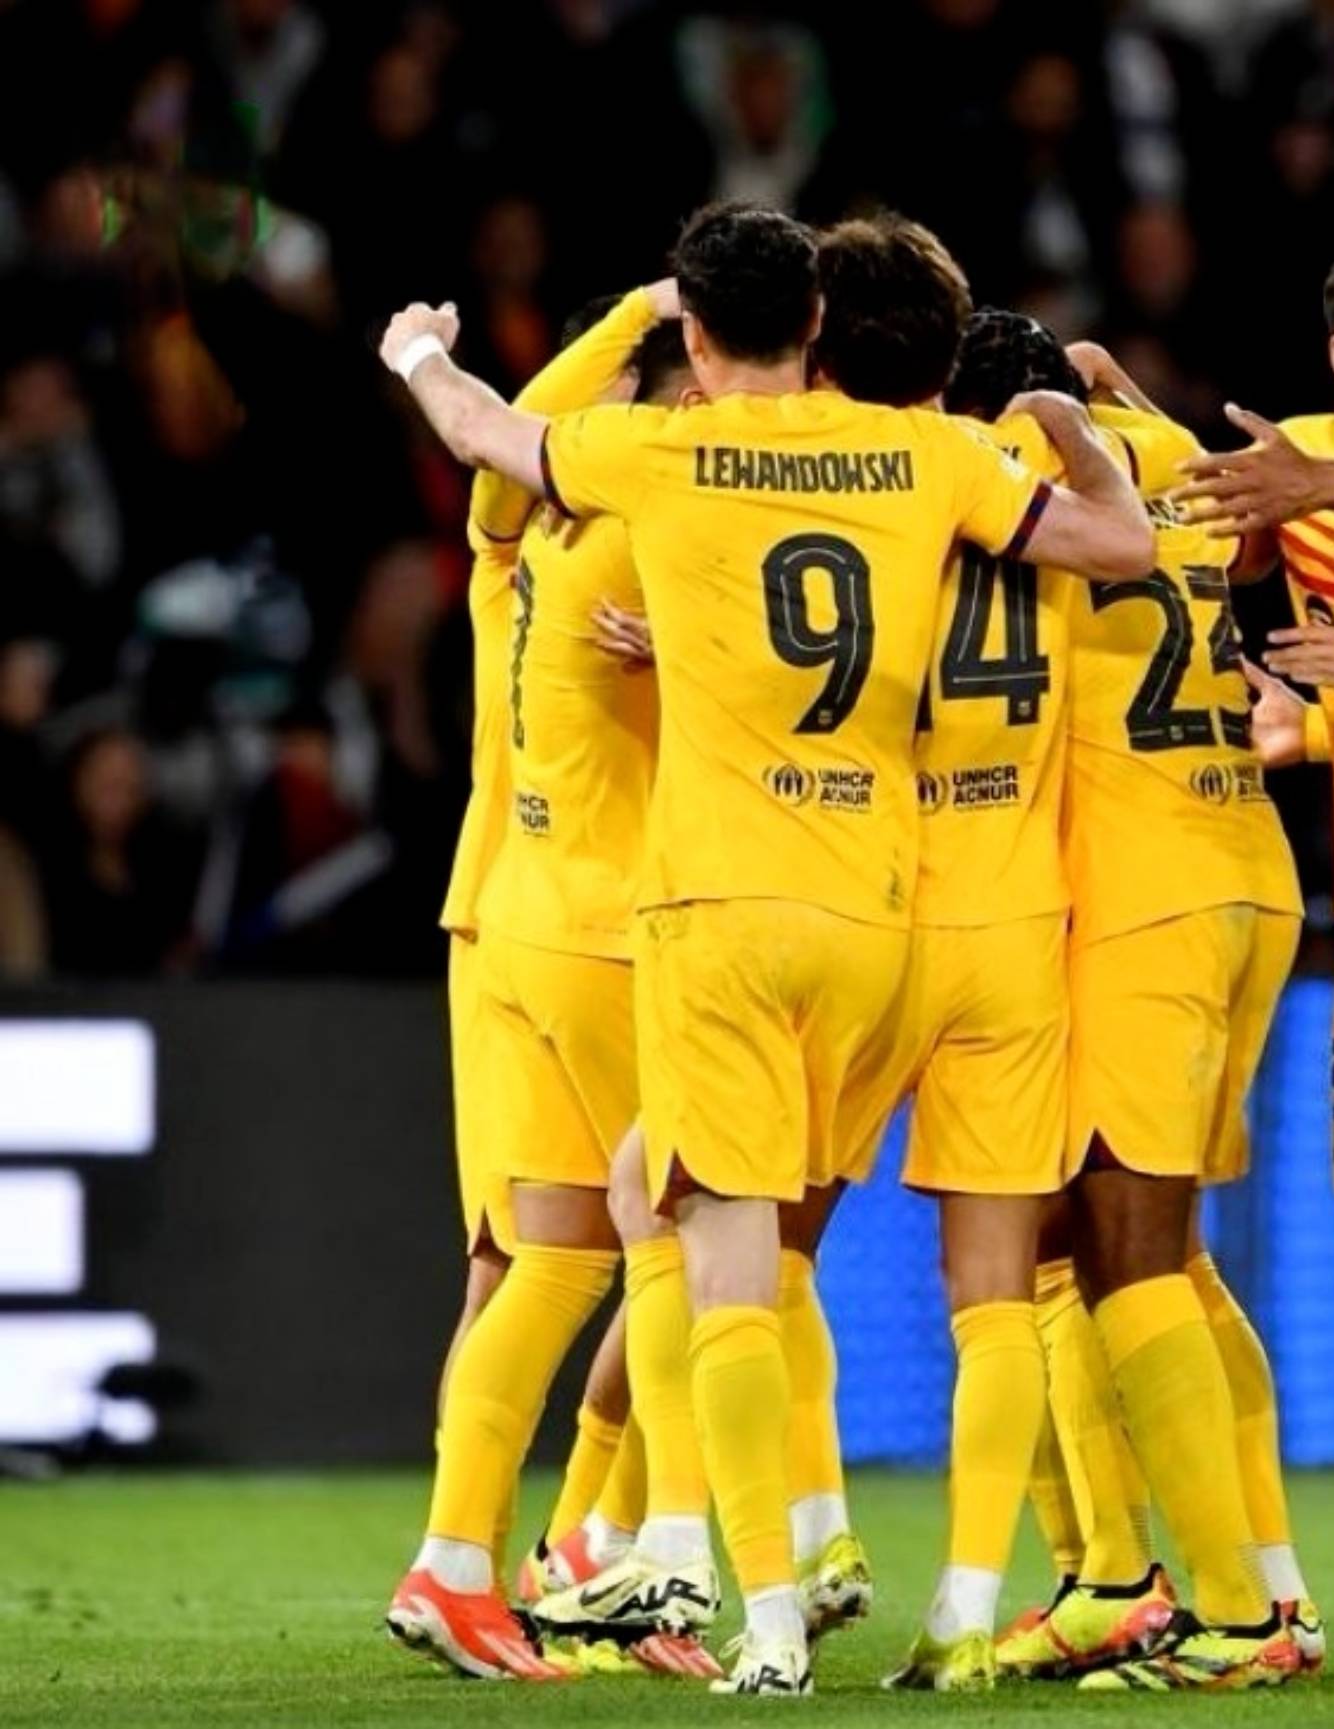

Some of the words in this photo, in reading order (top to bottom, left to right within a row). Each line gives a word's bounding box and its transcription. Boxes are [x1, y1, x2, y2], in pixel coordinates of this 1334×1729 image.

[694, 445, 915, 494] LEWANDOWSKI
[761, 532, 875, 735] 9
[915, 542, 1051, 733] 4
[952, 764, 1018, 786] UNHCR
[952, 782, 1019, 806] ACNUR
